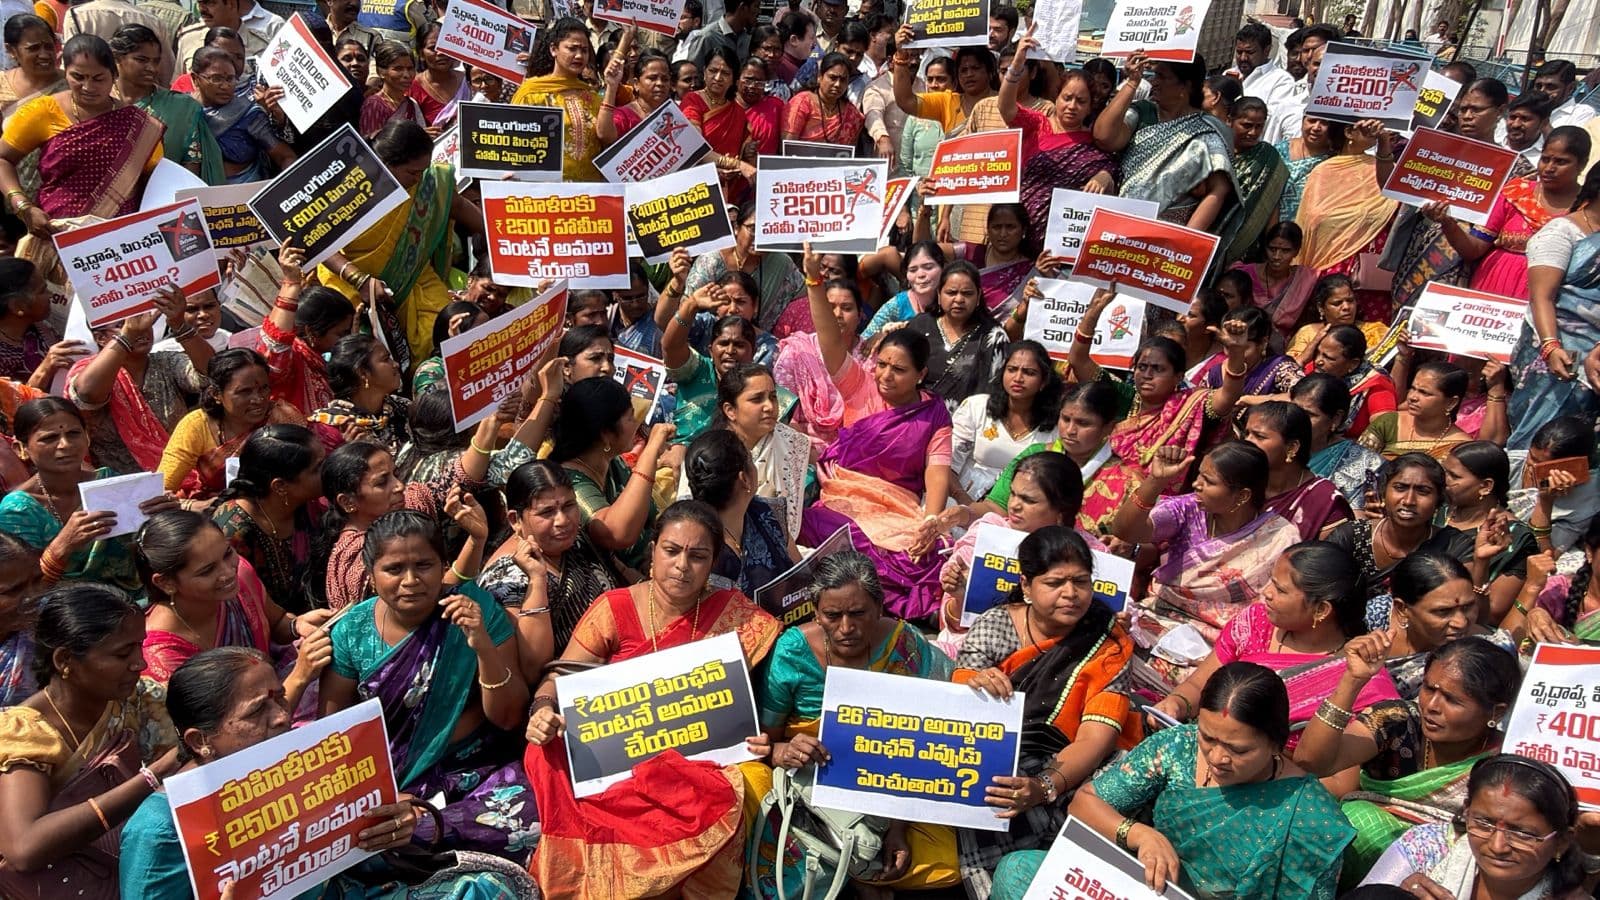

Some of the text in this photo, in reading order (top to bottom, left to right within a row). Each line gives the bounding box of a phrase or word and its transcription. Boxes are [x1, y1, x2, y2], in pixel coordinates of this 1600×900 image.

[362, 5, 395, 16] CITY POLICE
[944, 8, 980, 19] అమలు
[926, 22, 964, 34] చేయాలి
[1120, 28, 1168, 44] కాంగ్రెస్
[1331, 64, 1388, 77] మహిళలకు
[1314, 95, 1342, 108] హామీ
[480, 134, 510, 147] 6000
[513, 136, 548, 150] పింఛన్
[616, 136, 658, 176] మహిళలకు
[475, 150, 546, 166] హామీ ఏమైంది?
[934, 163, 978, 175] మహిళలకు
[986, 162, 1012, 172] 2500
[279, 160, 346, 214] దివ్యాంగులకు
[772, 179, 842, 195] మహిళలకు
[968, 176, 1010, 190] ఇస్తారు?
[1400, 173, 1486, 204] ఎప్పుడు ఇస్తారు?
[1404, 158, 1454, 180] మహిళలకు
[1464, 176, 1493, 192] 2500
[292, 196, 328, 228] 6000
[324, 166, 367, 204] పింఛన్
[504, 194, 596, 214] మహిళలకు
[666, 182, 710, 212] పింఛన్
[783, 194, 845, 217] 2500
[208, 218, 234, 230] ంఛన్
[303, 180, 374, 247] హామీ ఏమైంది?
[506, 218, 550, 236] 2500
[554, 218, 612, 236] హామీని
[636, 214, 671, 237] వెంటనే
[671, 203, 714, 226] అమలు
[762, 213, 855, 238] హామీ ఏమైంది?
[498, 237, 614, 258] వెంటనే అమలు
[658, 225, 702, 248] చేయాలి
[72, 249, 122, 274] వృద్ధాప్య
[122, 230, 164, 254] పింఛన్
[1088, 244, 1150, 266] మహిళలకు
[1160, 263, 1193, 280] 2500
[528, 261, 590, 279] చేయాలి
[1088, 260, 1186, 294] ఎప్పుడు ఇస్తారు?
[90, 288, 124, 308] హామీ
[468, 303, 548, 358] మహిళలకు
[469, 344, 514, 376] 2500
[460, 359, 514, 402] వెంటనే
[652, 659, 727, 698] పింఛన్
[1531, 682, 1586, 708] వృద్ధాప్య
[578, 688, 734, 744] వెంటనే అమలు
[837, 706, 1004, 744] 26 నెలలు అయ్యింది
[624, 721, 709, 760] చేయాలి
[854, 735, 982, 769] పింఛన్ ఎప్పుడు
[219, 730, 353, 813] మహిళలకు
[225, 791, 300, 850] 2500
[301, 755, 376, 811] హామీని
[214, 788, 383, 894] వెంటనే అమలు
[260, 834, 352, 898] చేయాలి
